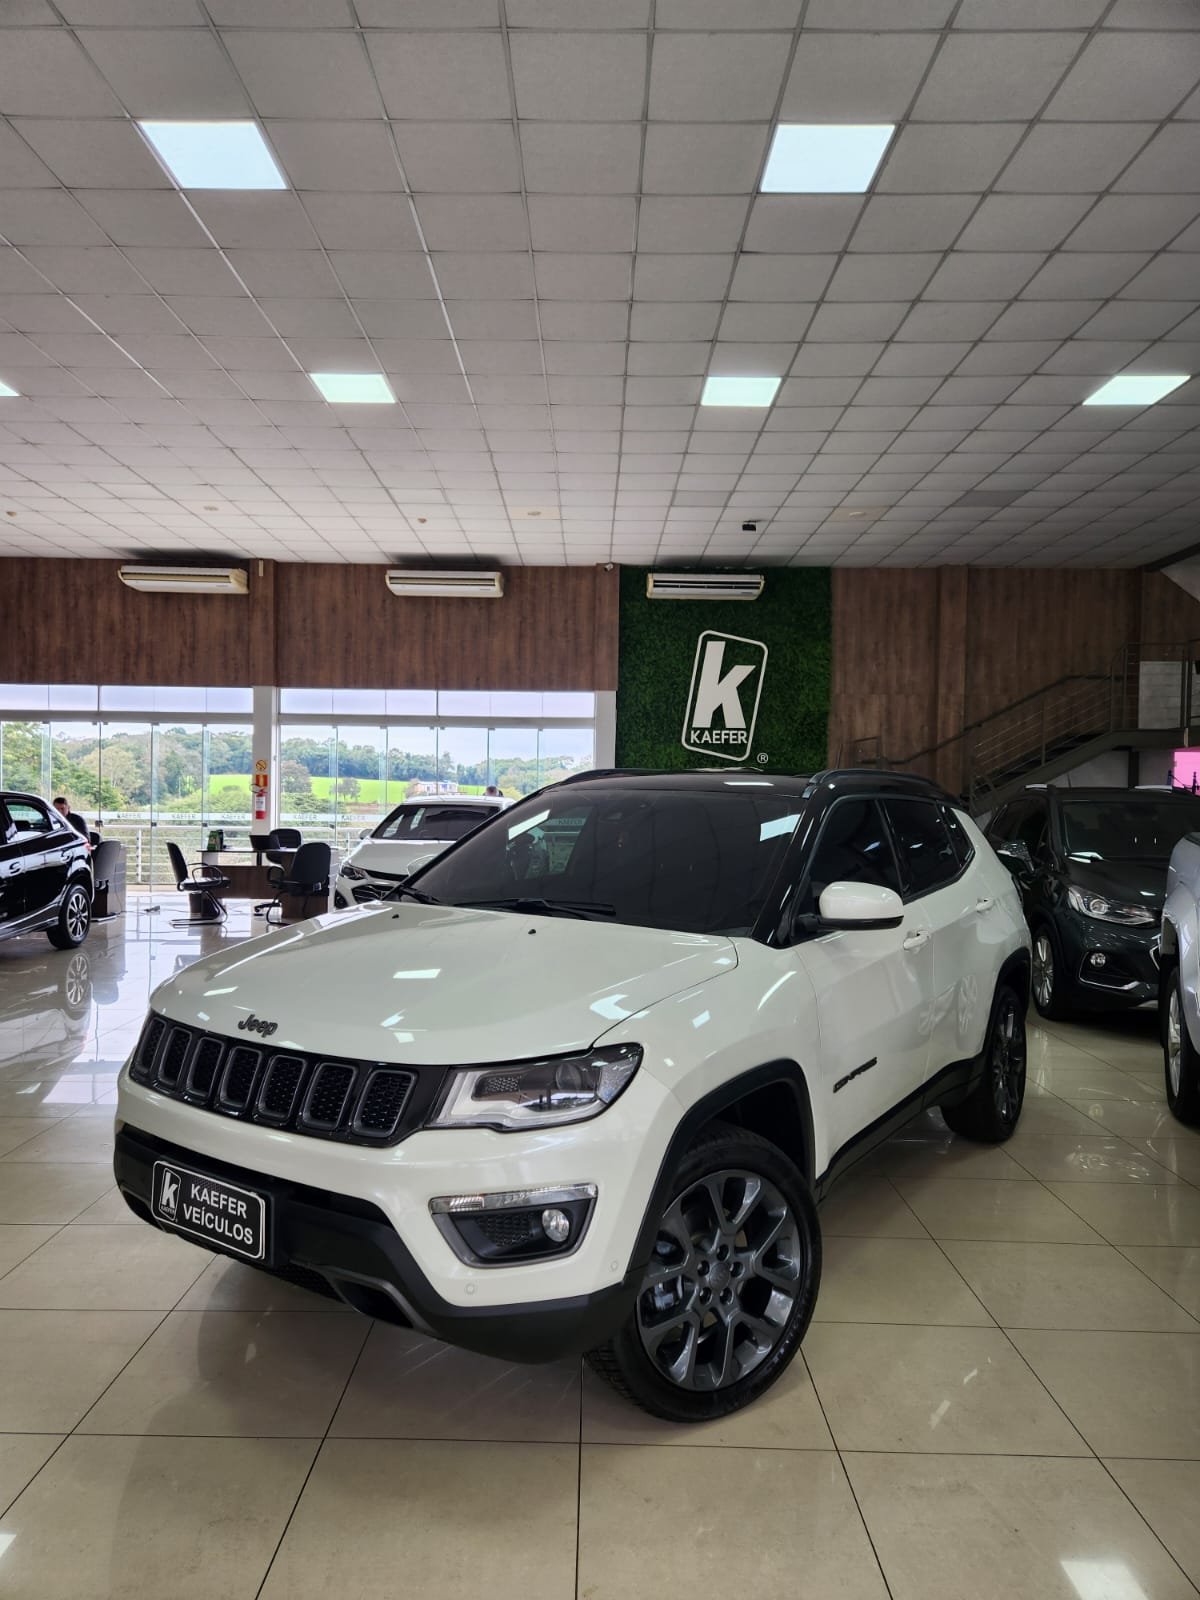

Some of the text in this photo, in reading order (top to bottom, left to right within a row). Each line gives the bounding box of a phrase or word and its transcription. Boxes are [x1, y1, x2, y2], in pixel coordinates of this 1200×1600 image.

[690, 730, 747, 744] KAEFER
[238, 1014, 279, 1038] Jeep
[191, 1183, 247, 1219] KAEFER
[183, 1203, 254, 1245] VEÍCULOS
